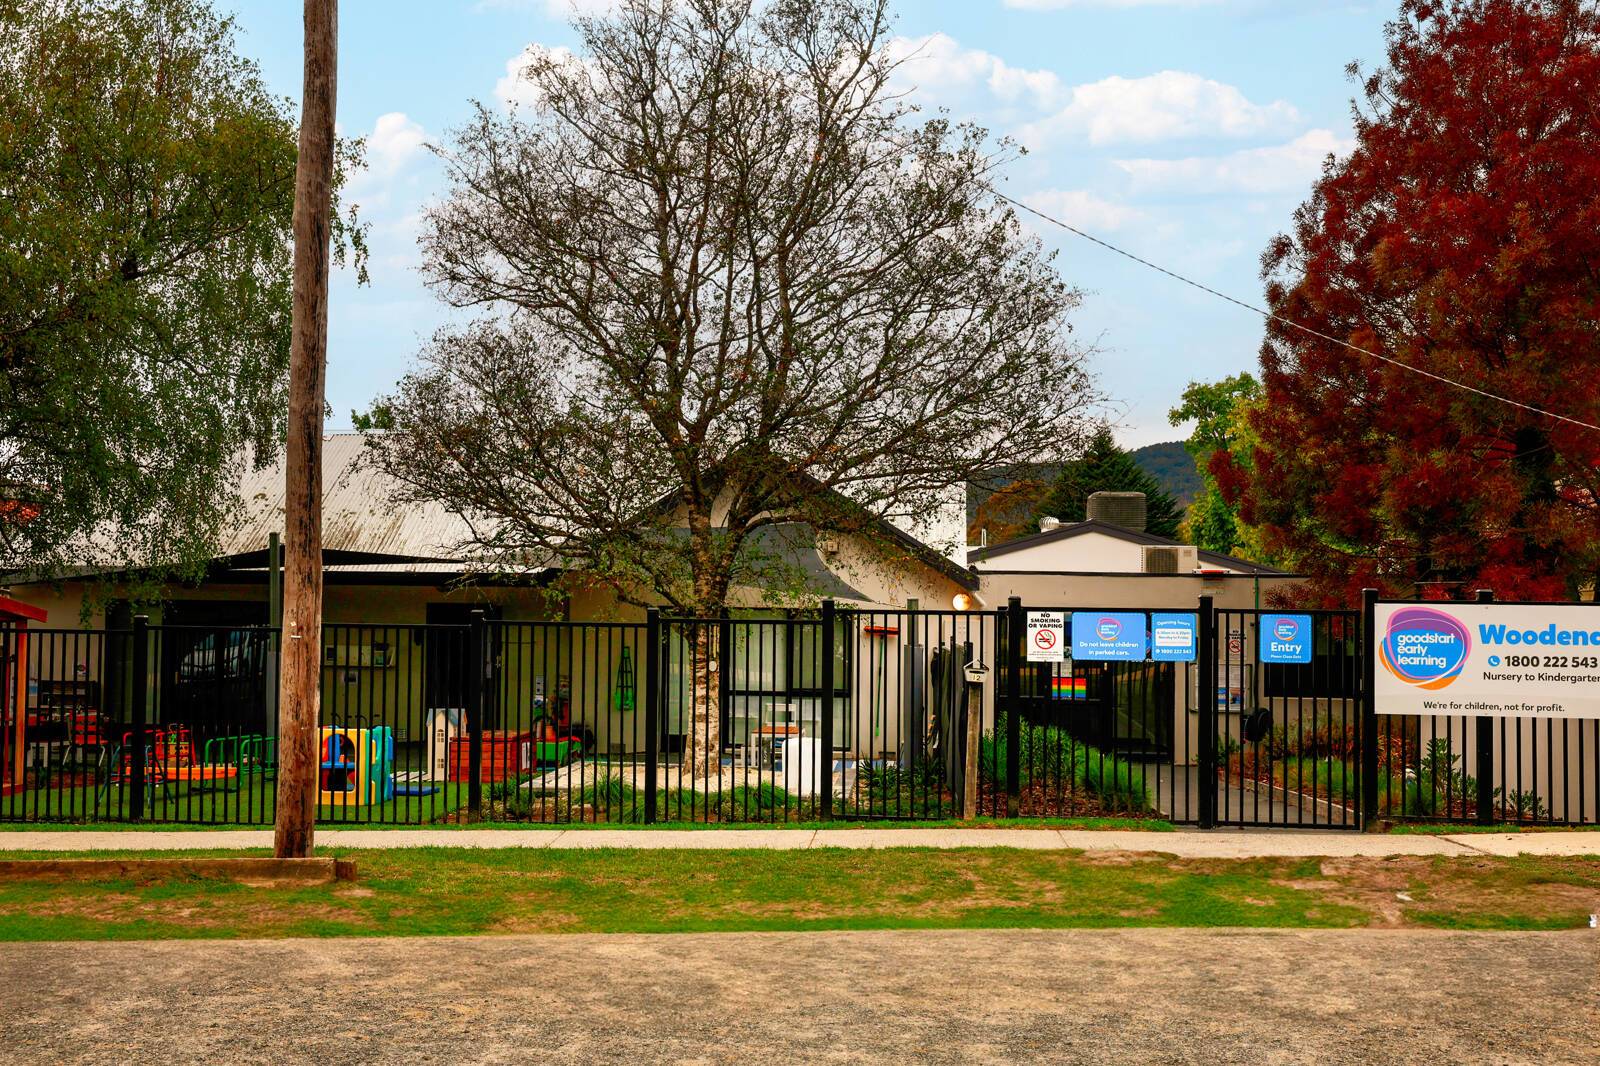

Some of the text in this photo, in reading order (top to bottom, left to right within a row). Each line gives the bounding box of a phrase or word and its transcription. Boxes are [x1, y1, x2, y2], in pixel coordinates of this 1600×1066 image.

[1397, 633, 1455, 646] goodstart
[1095, 649, 1115, 657] parked
[1271, 642, 1302, 654] Entry
[1397, 643, 1428, 656] early
[1397, 654, 1447, 669] learning
[1504, 655, 1598, 669] 1800 222 543
[1483, 671, 1522, 682] Nursery
[1524, 673, 1535, 681] to
[1423, 701, 1448, 709] We're
[1449, 701, 1463, 710] for
[1464, 702, 1502, 711] children,
[1521, 703, 1535, 711] for
[1536, 703, 1565, 713] profit.
